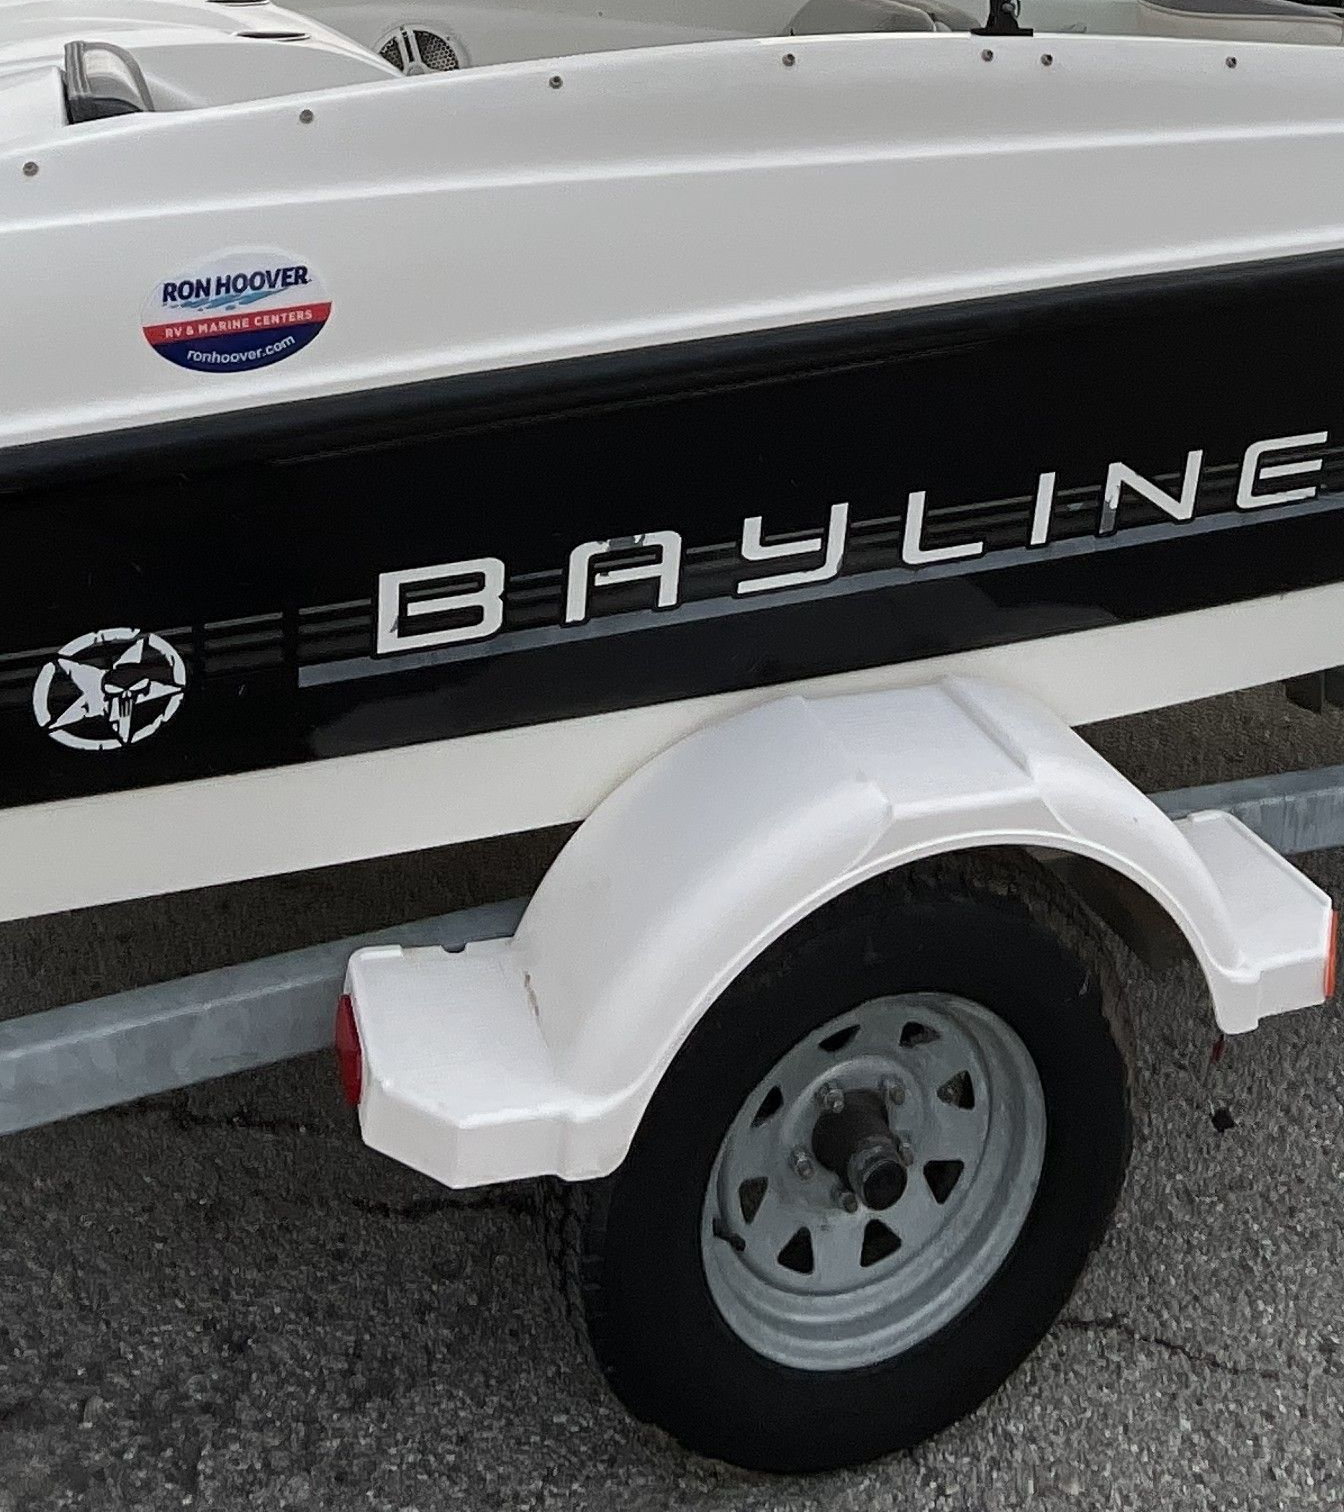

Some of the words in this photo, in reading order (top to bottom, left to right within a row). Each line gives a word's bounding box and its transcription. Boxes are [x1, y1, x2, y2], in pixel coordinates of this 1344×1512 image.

[162, 278, 212, 303] RON
[214, 265, 309, 296] HOOVER
[165, 328, 183, 339] RV
[186, 326, 194, 335] &
[198, 318, 250, 334] MARINE
[254, 309, 313, 326] CENTERS
[186, 335, 296, 364] ronhoover.com
